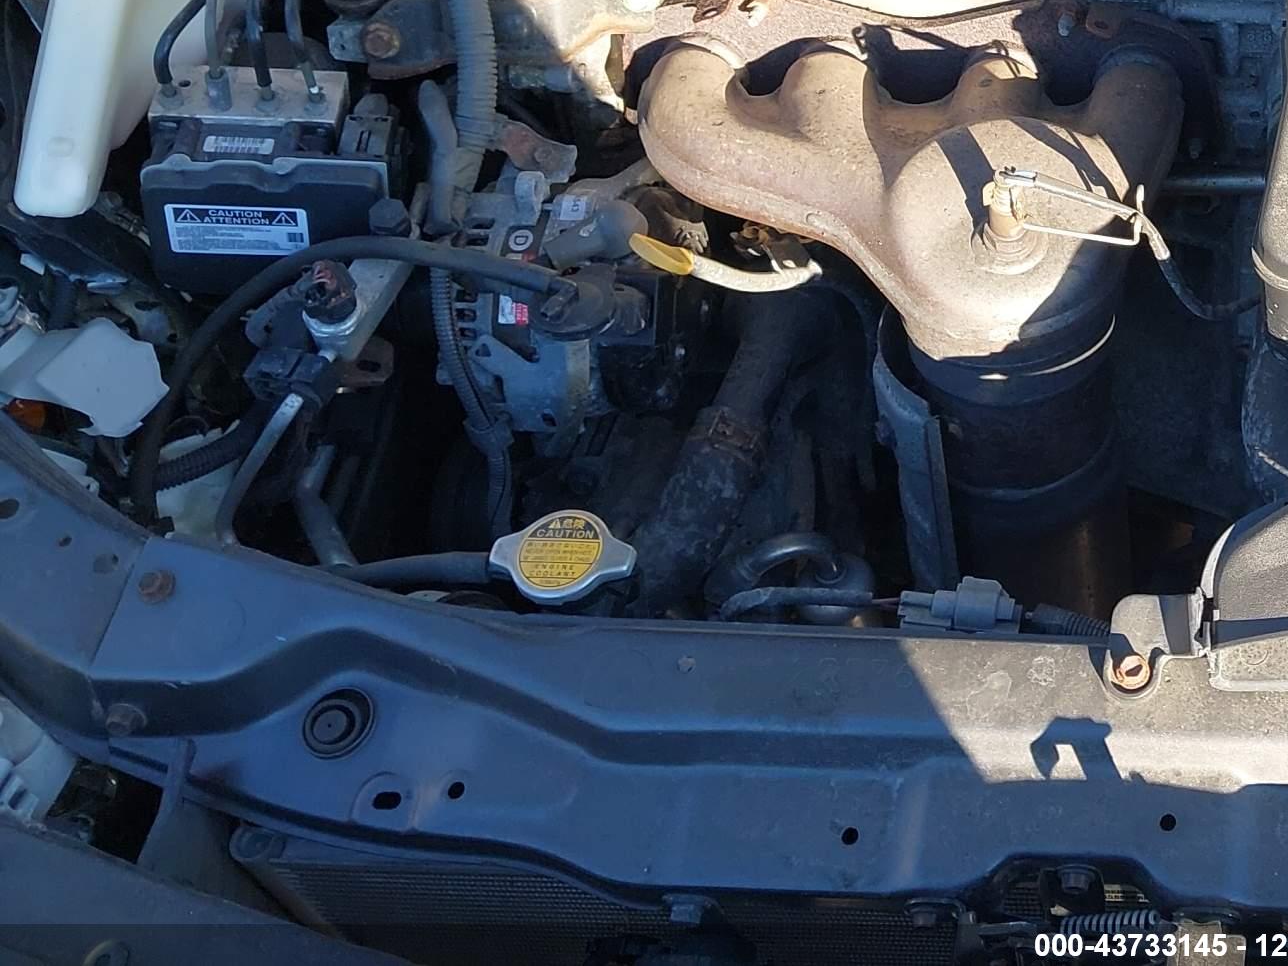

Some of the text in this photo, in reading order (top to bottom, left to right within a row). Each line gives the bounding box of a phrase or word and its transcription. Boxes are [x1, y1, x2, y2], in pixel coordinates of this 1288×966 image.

[208, 209, 263, 218] CAUTION
[203, 216, 270, 225] ATTENTION
[536, 528, 595, 539] CAUTION
[535, 563, 575, 571] ENGINE
[528, 570, 577, 578] COOLANT
